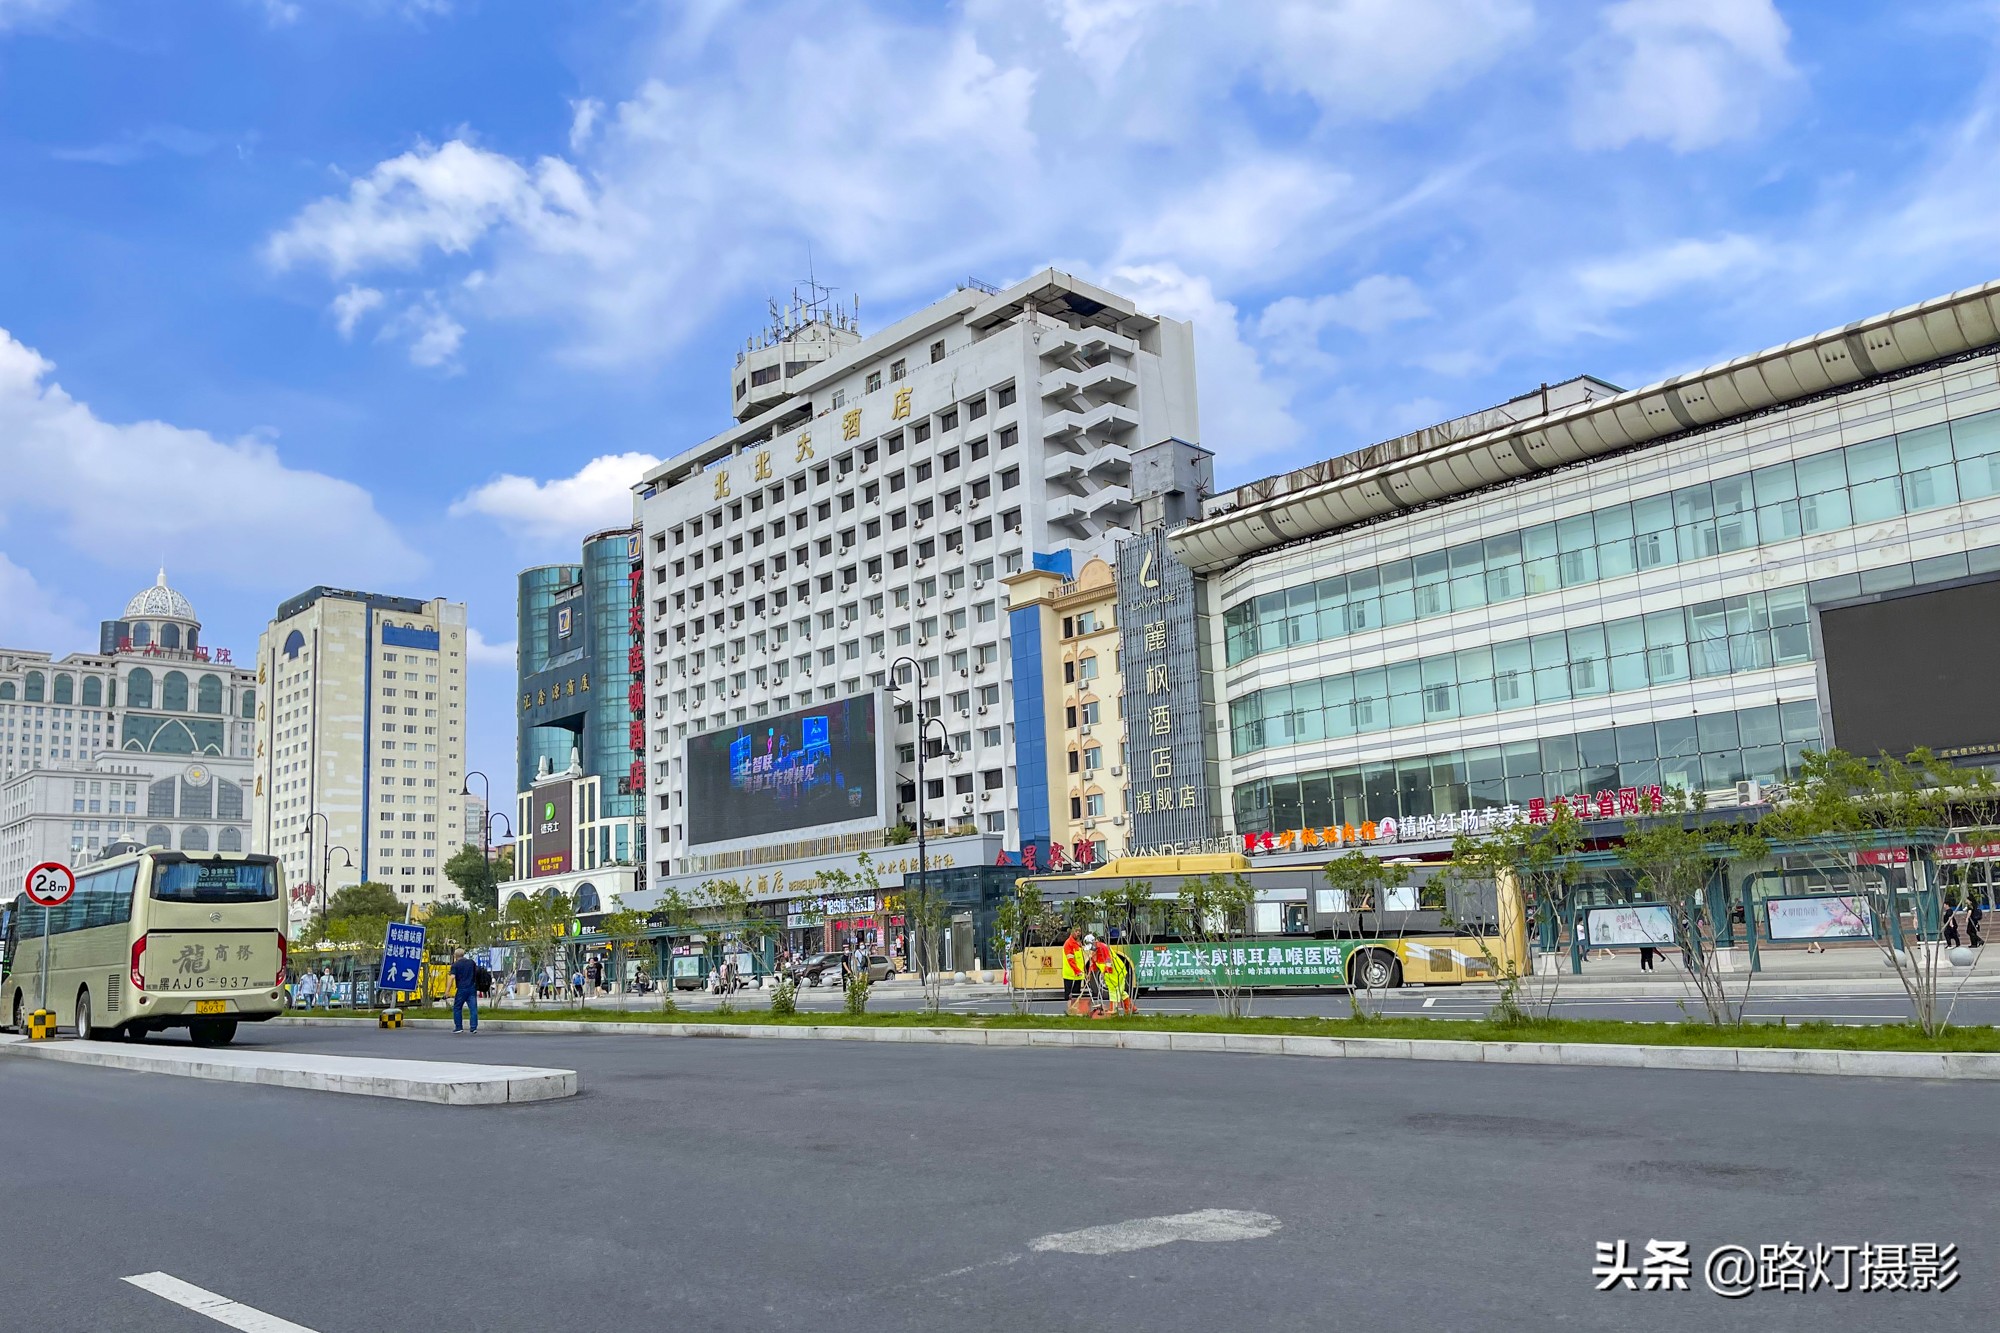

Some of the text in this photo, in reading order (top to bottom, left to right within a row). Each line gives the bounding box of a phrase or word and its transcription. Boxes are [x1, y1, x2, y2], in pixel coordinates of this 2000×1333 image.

[713, 386, 913, 501] 北北大酒店
[1131, 593, 1176, 611] LAVANDE
[628, 569, 646, 790] 7天连锁酒店
[1135, 784, 1197, 815] 旗舰店
[1528, 784, 1663, 824] 黑龙江省网络
[540, 821, 560, 835] 德克士
[1398, 803, 1520, 837] 精哈红肠专卖
[391, 928, 422, 944] 哈站南站房
[387, 944, 421, 960] 进站地下通道
